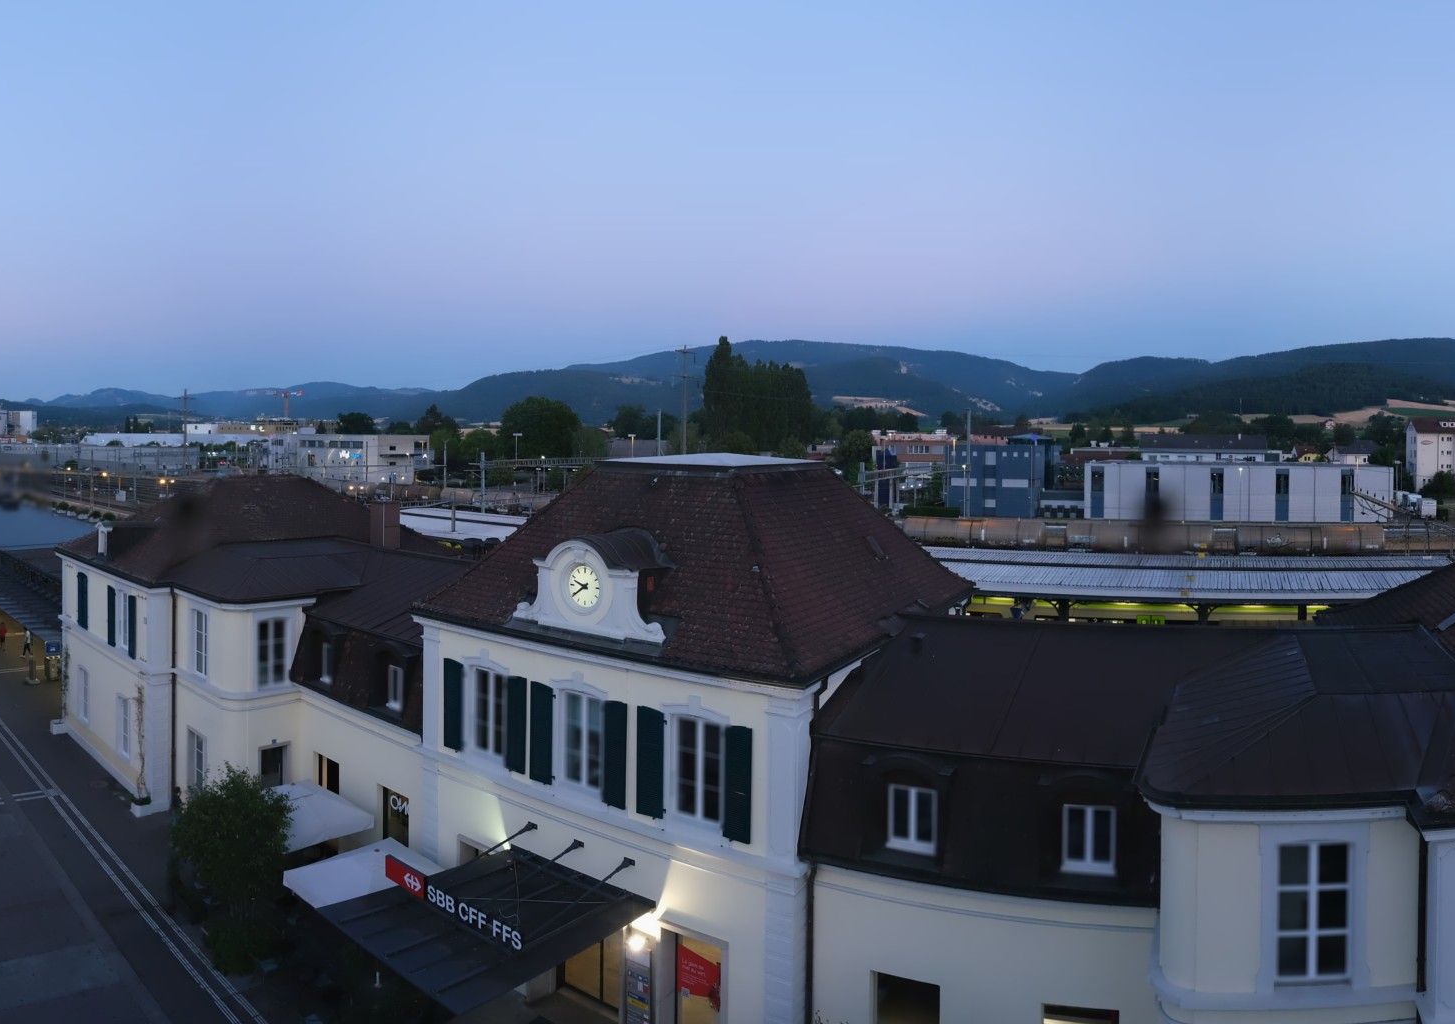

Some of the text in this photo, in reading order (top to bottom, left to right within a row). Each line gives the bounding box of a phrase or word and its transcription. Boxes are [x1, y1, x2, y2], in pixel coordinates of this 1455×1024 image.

[427, 885, 522, 950] SBB CFF FFS
